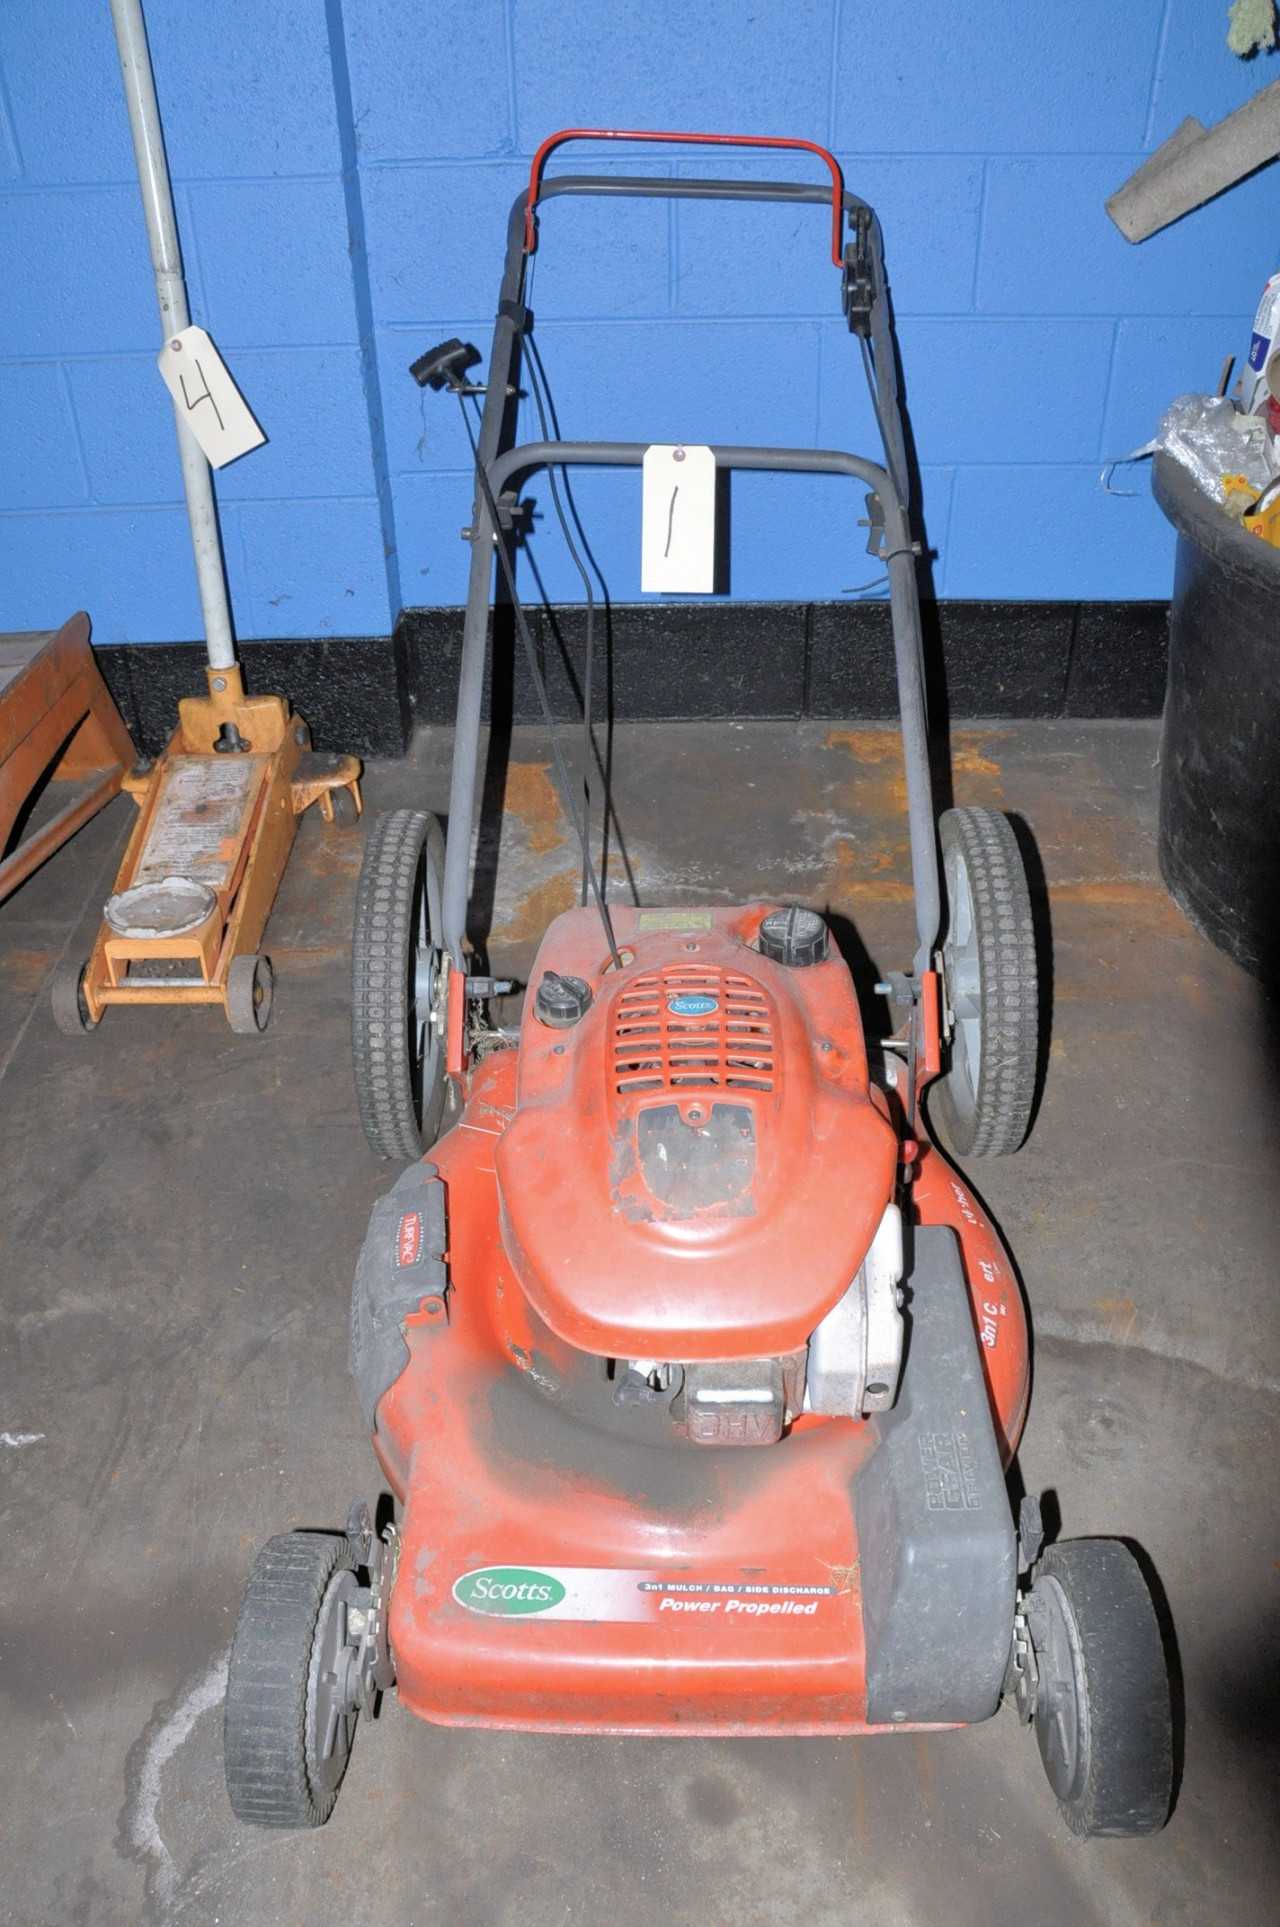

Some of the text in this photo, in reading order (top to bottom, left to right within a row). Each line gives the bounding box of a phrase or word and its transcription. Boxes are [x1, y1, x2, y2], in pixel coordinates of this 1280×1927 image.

[179, 359, 225, 432] 4
[696, 1412, 769, 1441] OHV
[471, 1577, 553, 1601] Scotts
[644, 1583, 663, 1592] 3n1
[667, 1583, 703, 1592] MULCH
[713, 1585, 735, 1593] BAG
[745, 1586, 769, 1594] SIDE
[772, 1586, 831, 1595] DISCHARGE
[659, 1597, 818, 1617] Power Propelled
